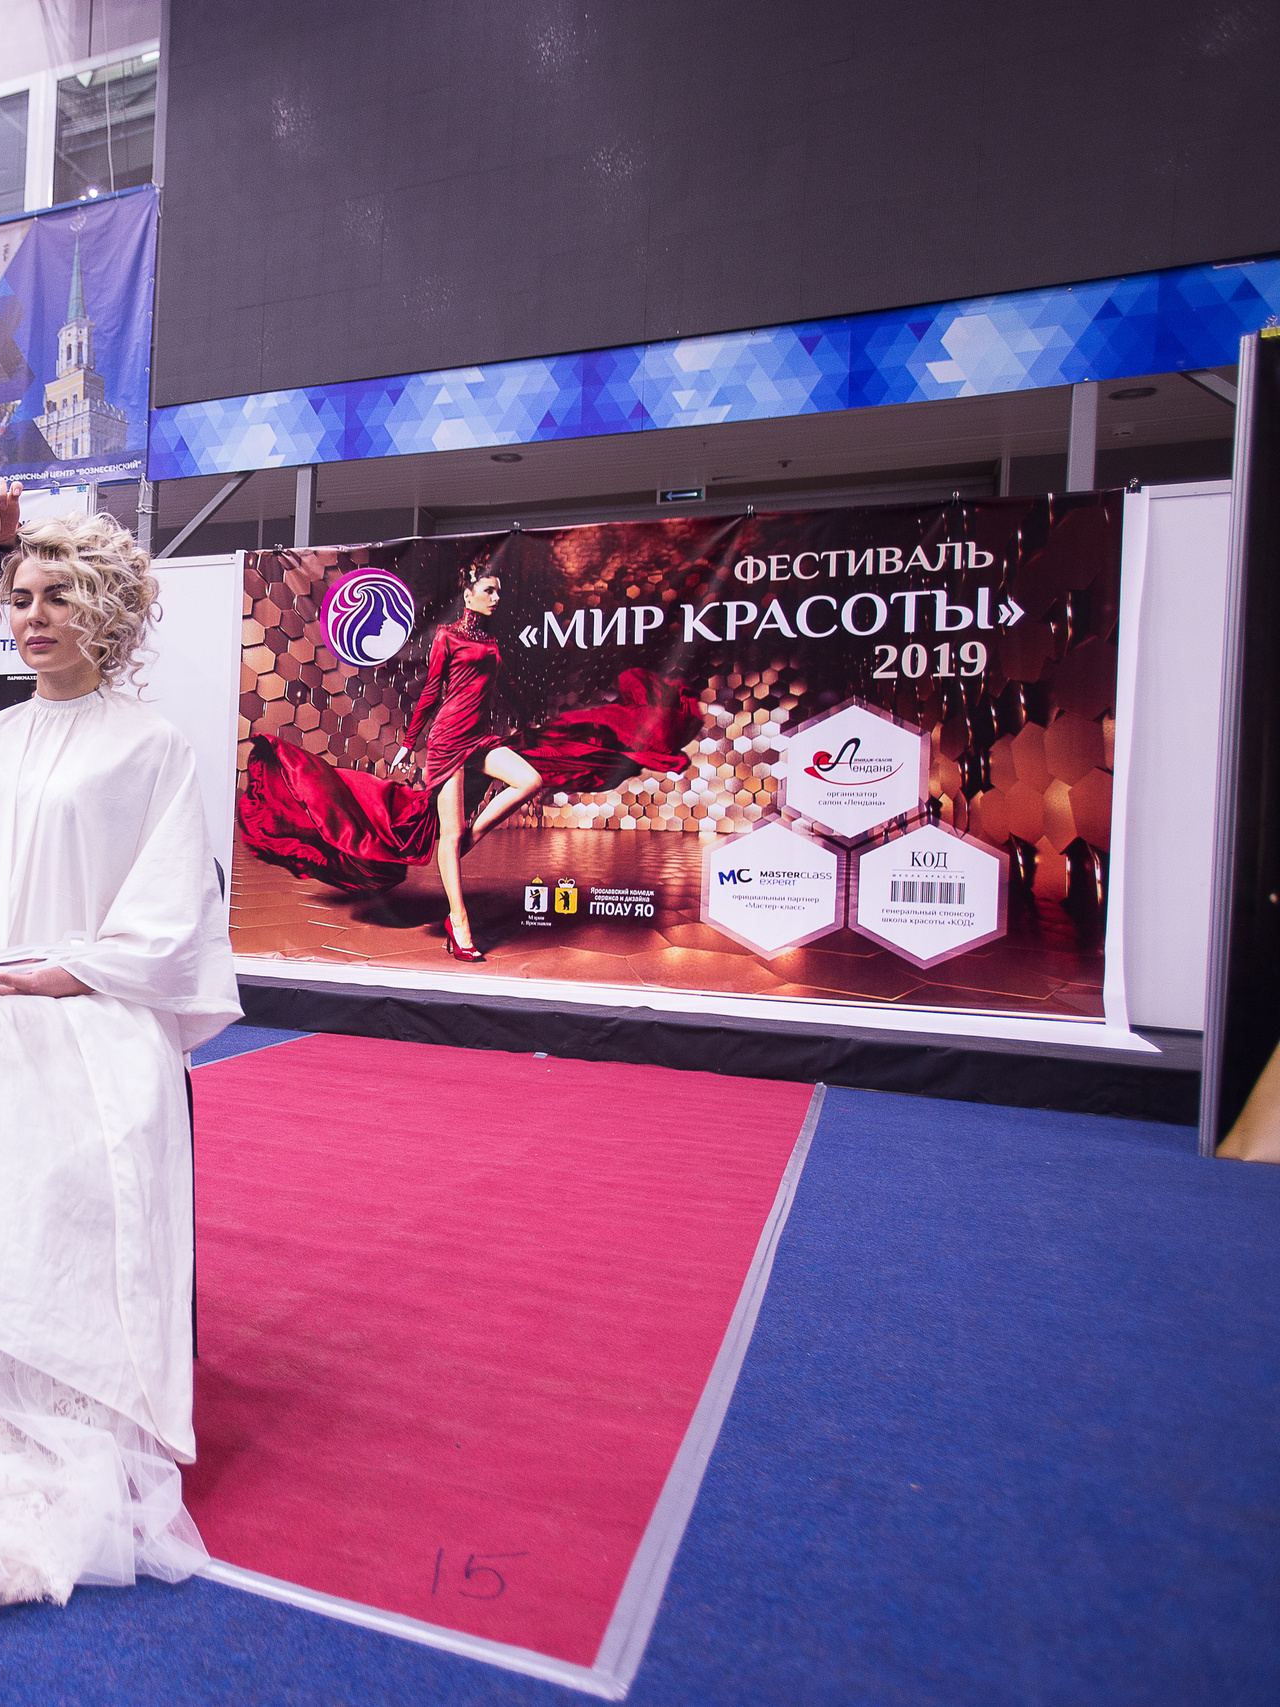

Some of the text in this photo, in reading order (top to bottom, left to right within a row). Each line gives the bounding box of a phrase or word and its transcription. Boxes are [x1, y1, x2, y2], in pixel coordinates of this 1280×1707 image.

[50, 469, 76, 479] ЦЕНТР
[734, 541, 994, 584] ФЕСТИВАЛЬ
[519, 587, 1025, 649] «МИР КРАСОТЫ»
[873, 641, 988, 680] 2019
[816, 737, 893, 774] Лендана
[910, 851, 948, 869] КОД
[590, 886, 655, 897] Ярославский колледж
[589, 901, 654, 917] ГПОАУ ЯО
[881, 908, 937, 916] генеральный
[431, 1548, 530, 1600] 15
